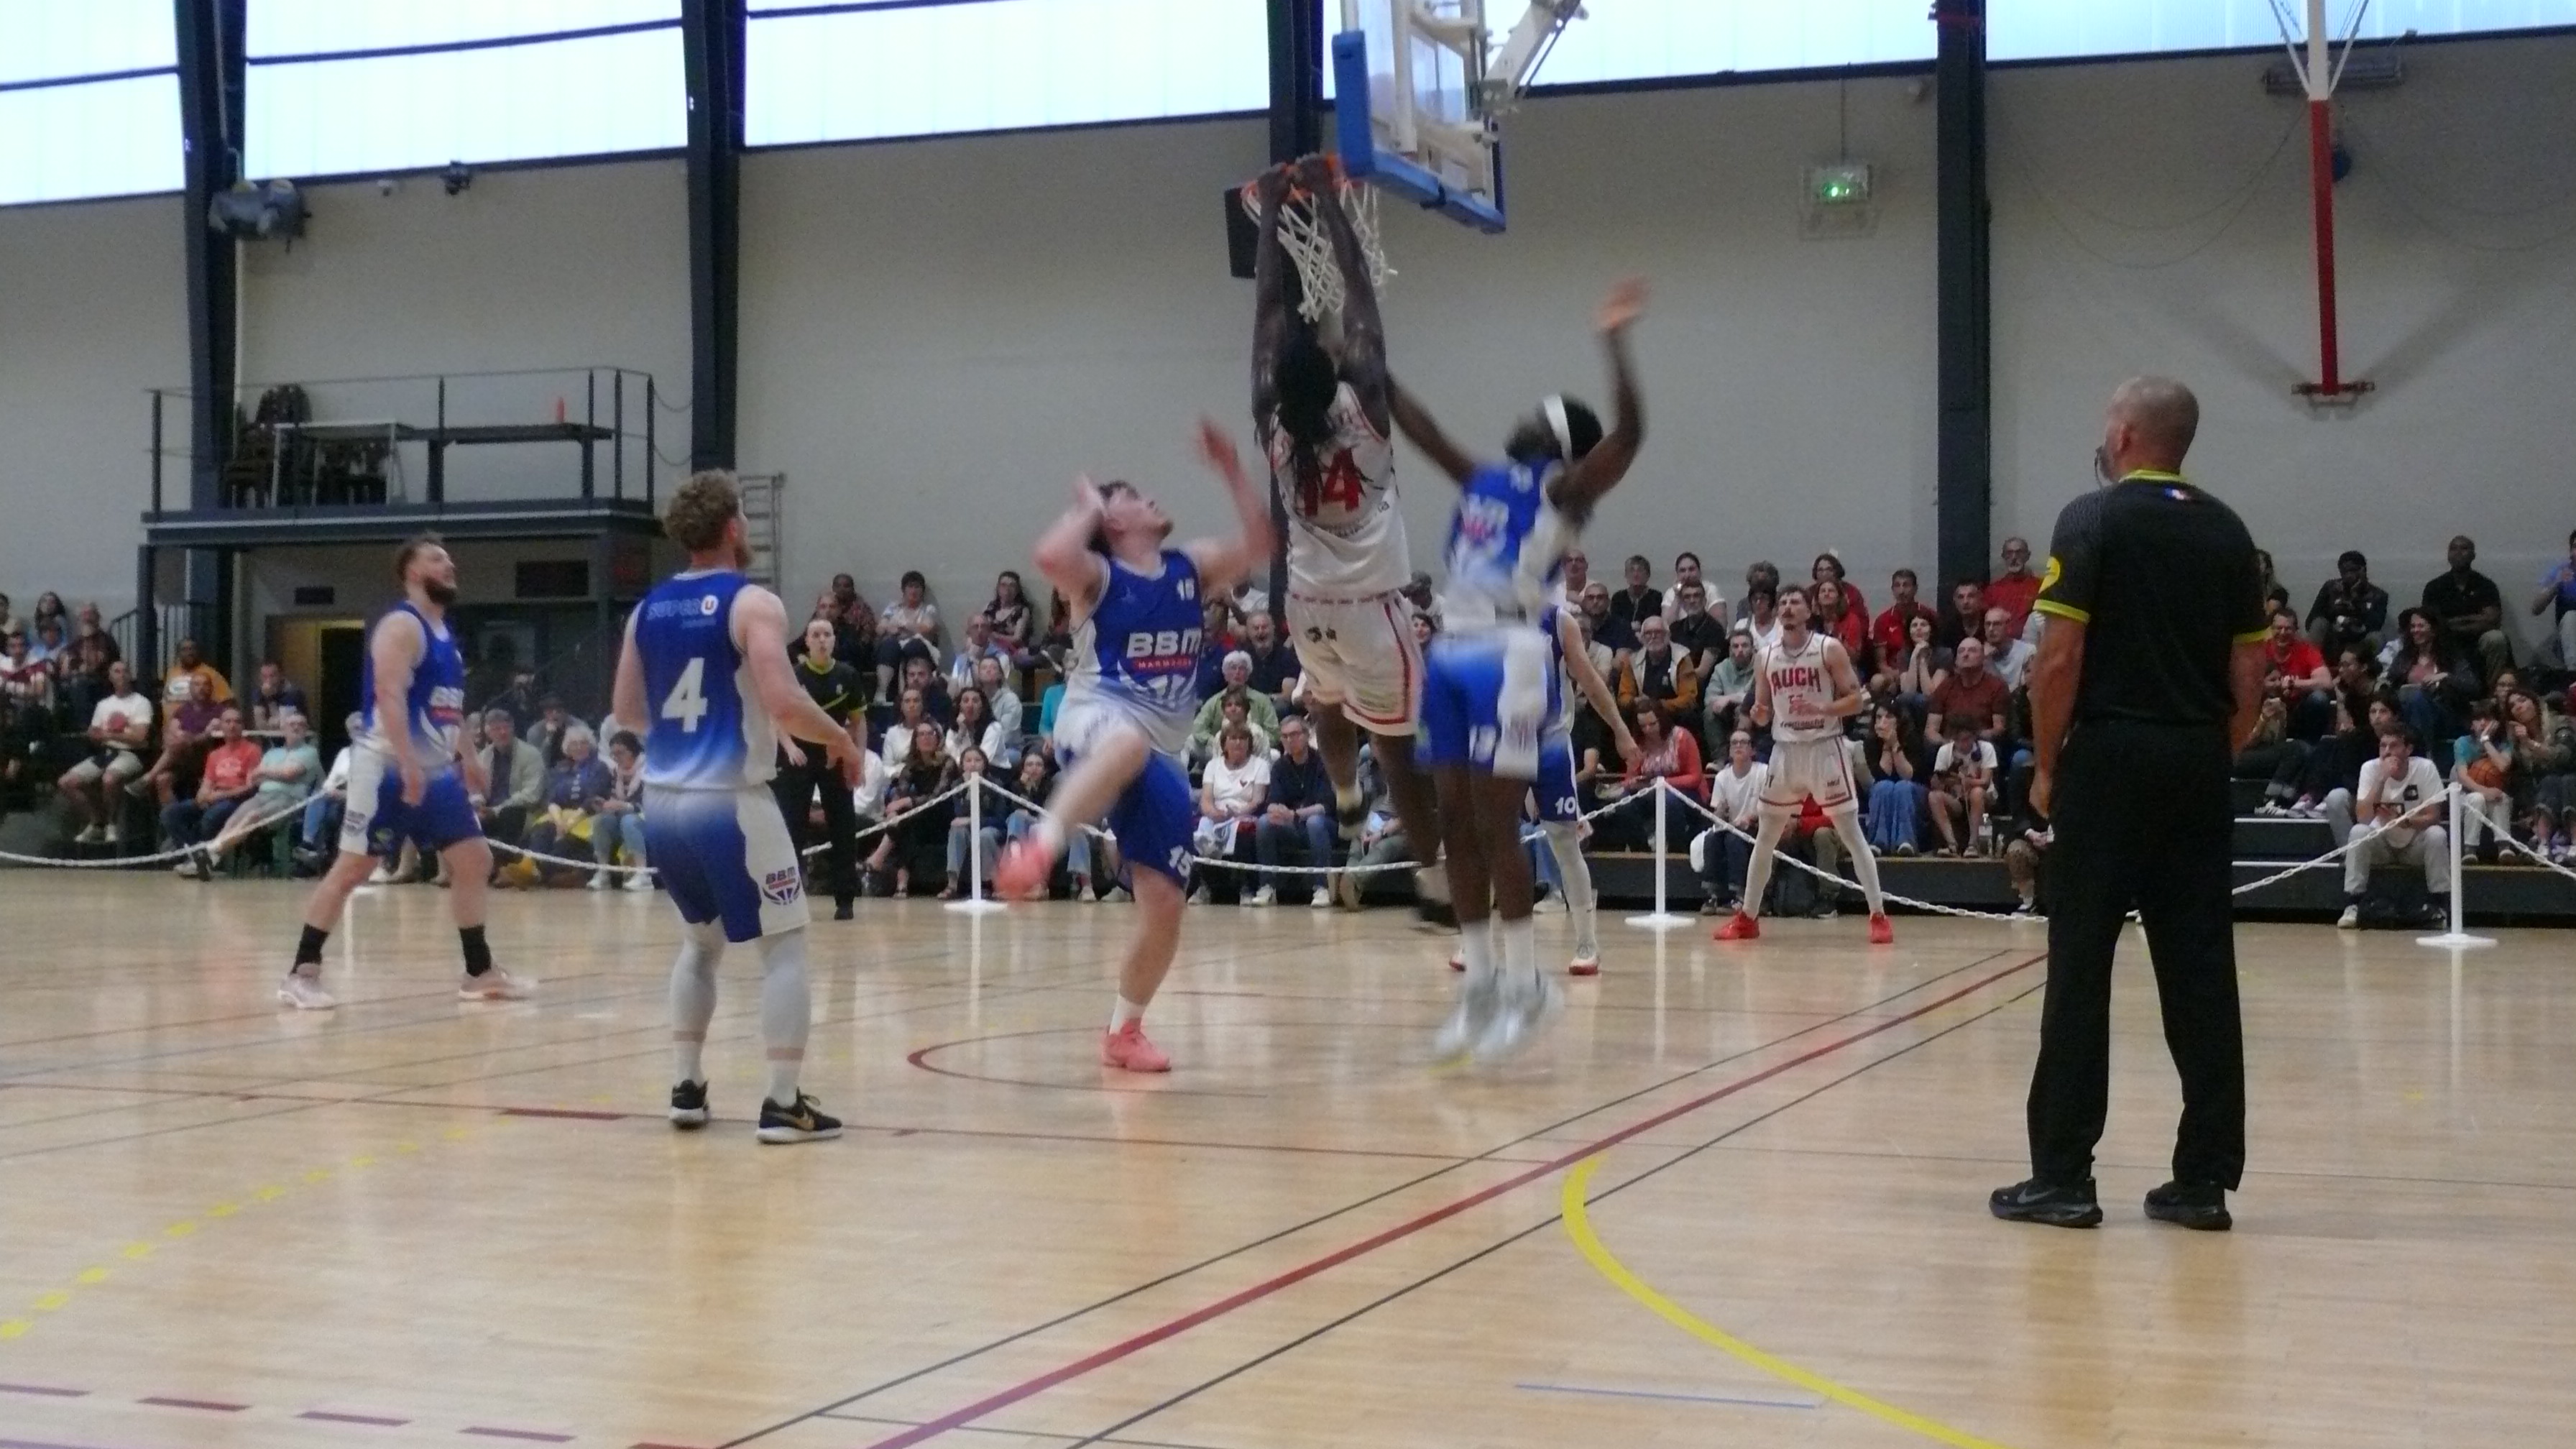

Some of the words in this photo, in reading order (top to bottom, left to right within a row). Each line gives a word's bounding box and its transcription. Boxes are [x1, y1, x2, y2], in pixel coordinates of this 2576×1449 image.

[1126, 627, 1202, 658] BBM
[661, 657, 708, 732] 4
[1771, 666, 1821, 697] AUCH
[1555, 796, 1576, 815] 10
